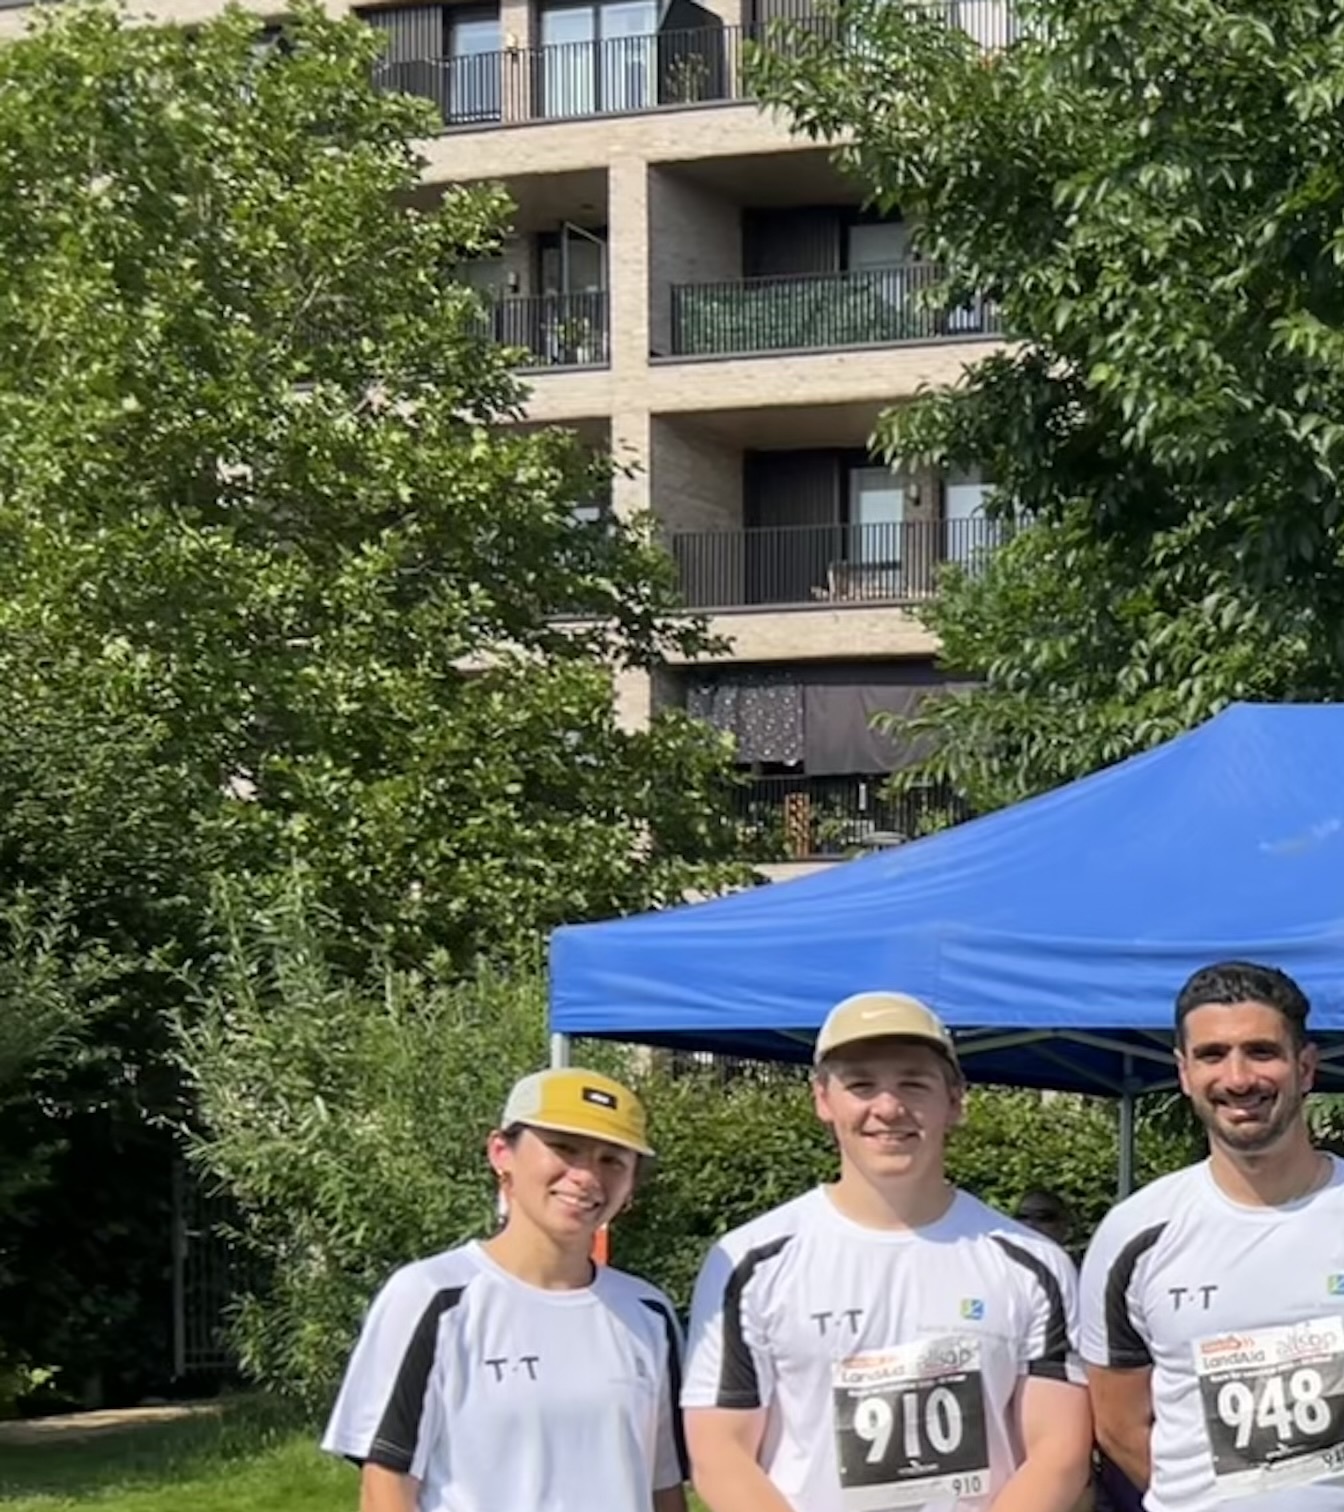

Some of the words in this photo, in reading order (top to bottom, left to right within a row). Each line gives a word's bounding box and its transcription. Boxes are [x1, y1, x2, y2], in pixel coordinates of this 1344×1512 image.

[854, 1386, 963, 1463] 910
[1216, 1367, 1332, 1449] 948
[952, 1475, 982, 1497] 910
